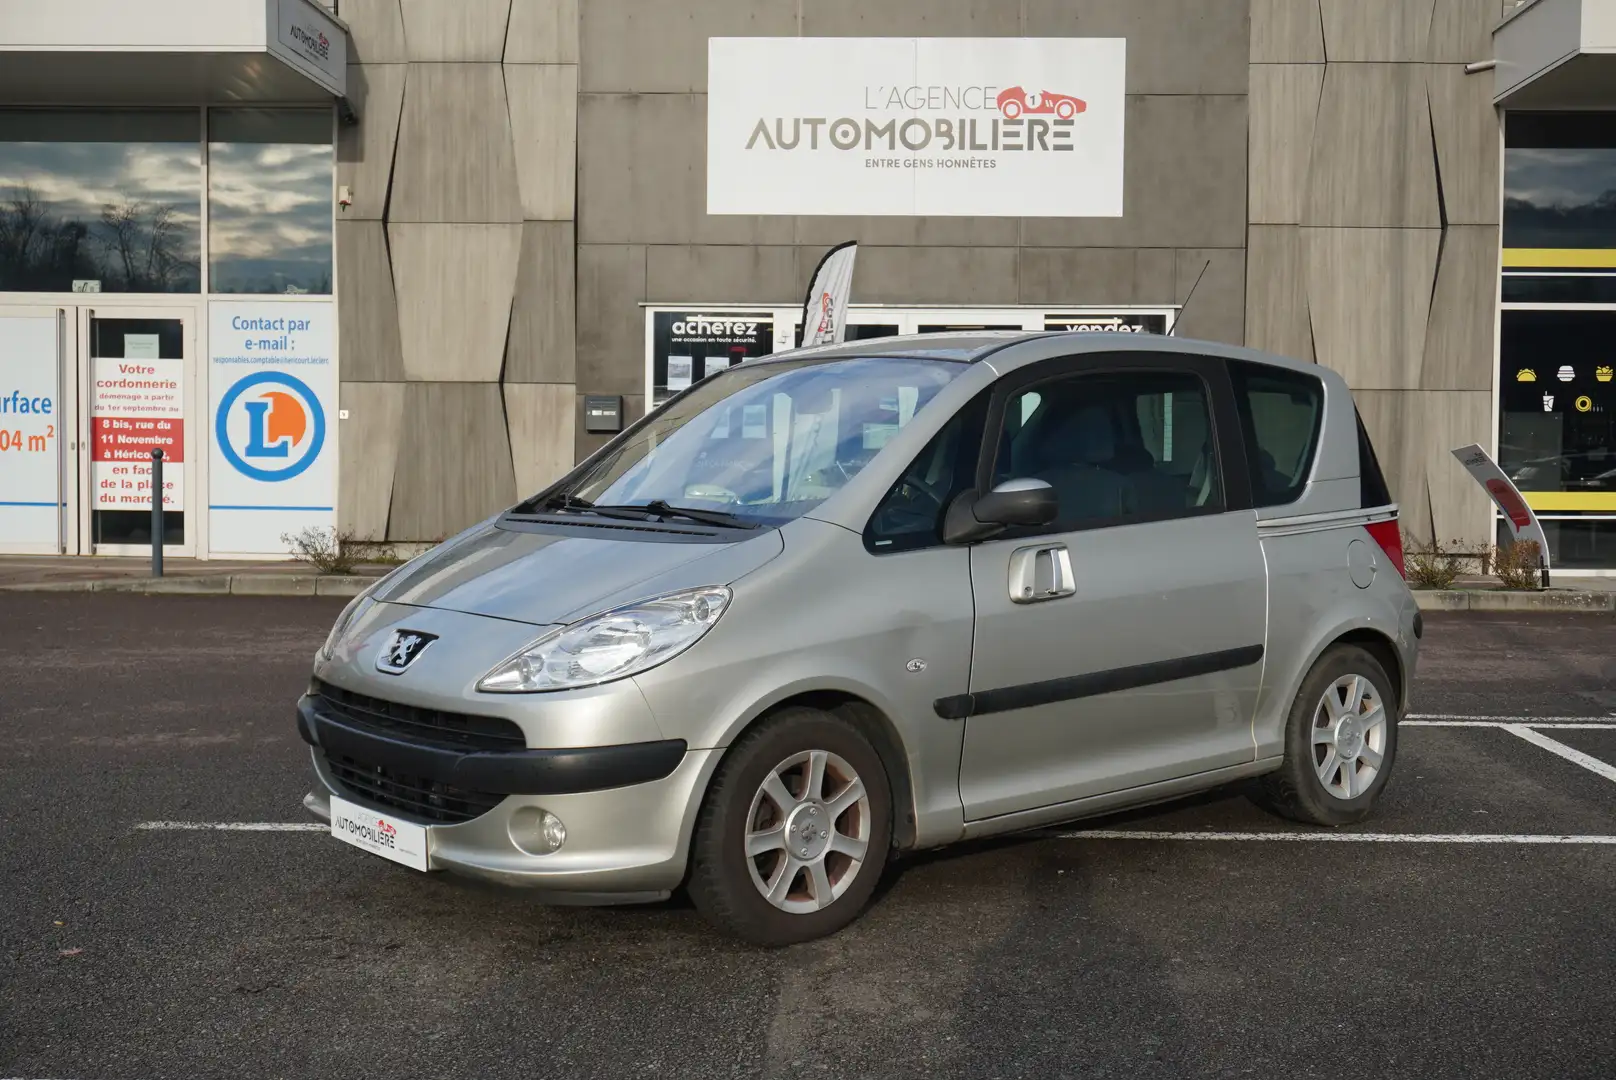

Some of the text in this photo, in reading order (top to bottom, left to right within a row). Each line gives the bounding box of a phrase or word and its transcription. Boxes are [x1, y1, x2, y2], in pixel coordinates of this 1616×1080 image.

[865, 86, 998, 110] L'AGENCE
[865, 156, 997, 168] ENTRE GENS HONNÊTES
[232, 315, 311, 334] Contact par
[671, 315, 757, 335] achetez
[244, 335, 288, 350] e-mail
[119, 364, 155, 374] Votre
[96, 379, 177, 389] cordonnerie
[0, 390, 52, 414] rface
[103, 419, 171, 430] 8 bis, rue du
[101, 435, 173, 445] 11 Novembre
[104, 449, 111, 459] à
[112, 465, 153, 475] en fac
[100, 479, 116, 489] de
[121, 479, 133, 489] la
[100, 494, 116, 503] du
